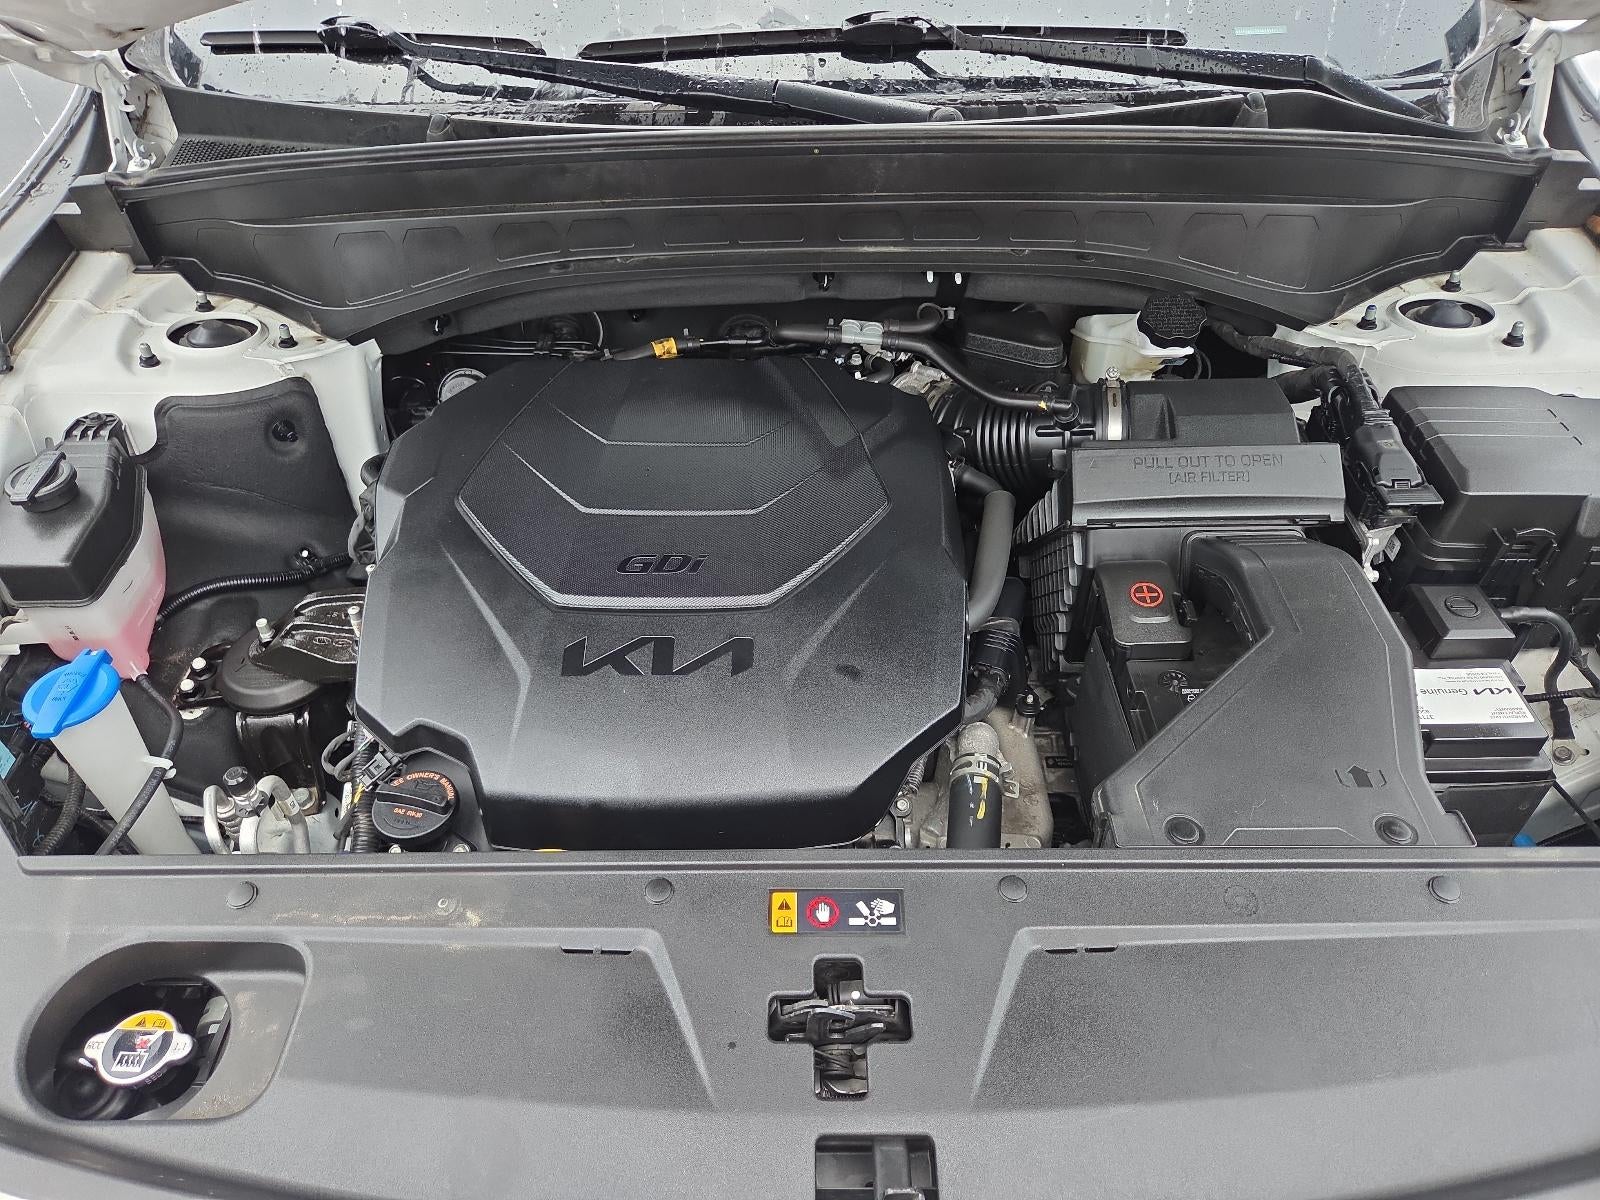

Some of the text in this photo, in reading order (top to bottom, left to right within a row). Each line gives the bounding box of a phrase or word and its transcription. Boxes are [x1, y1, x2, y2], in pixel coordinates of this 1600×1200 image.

[1132, 453, 1283, 470] PULL OUT TO OPEN
[616, 553, 710, 575] GDi
[560, 635, 755, 677] KIA
[1419, 687, 1513, 697] KIA Genuine
[406, 772, 440, 780] OWNER'S
